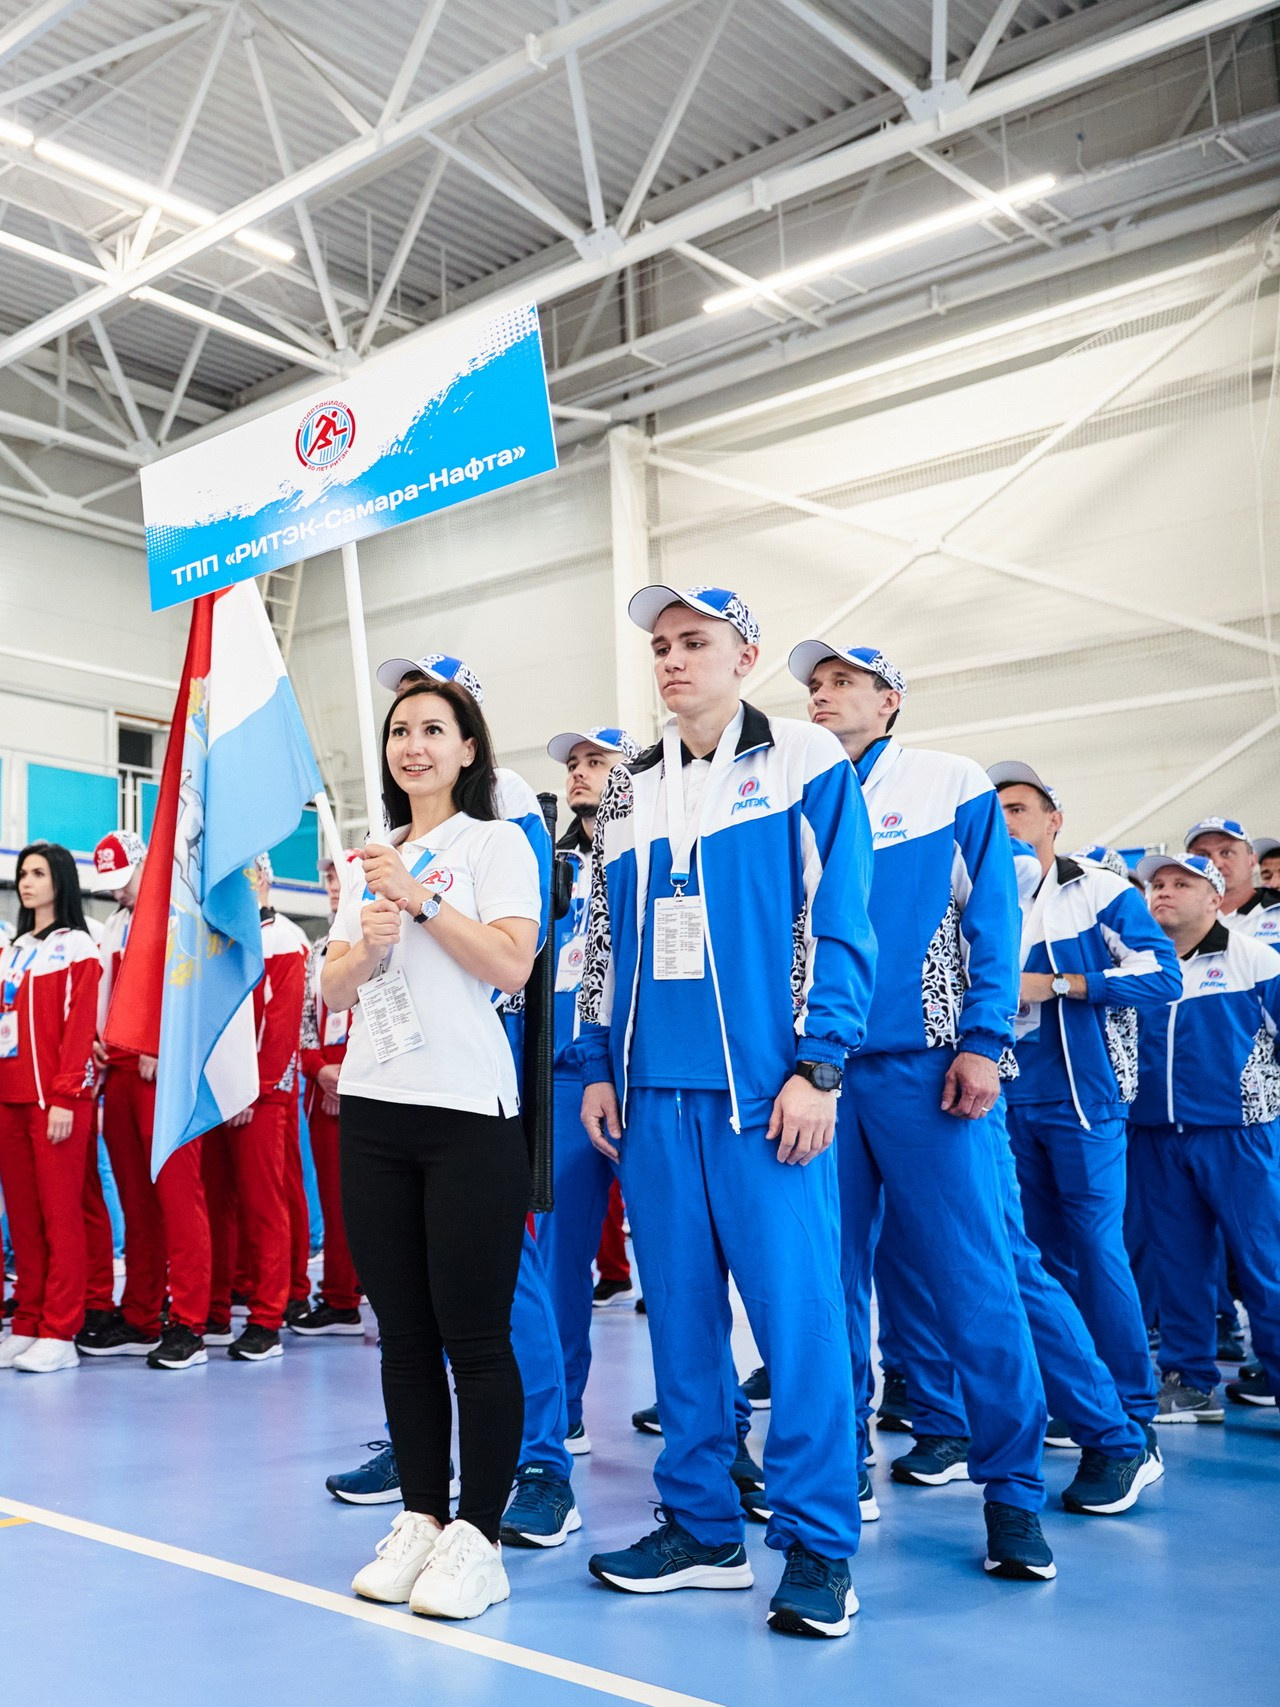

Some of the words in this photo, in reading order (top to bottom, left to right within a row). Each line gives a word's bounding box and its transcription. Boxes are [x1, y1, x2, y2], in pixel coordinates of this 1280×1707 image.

[300, 400, 347, 428] СПАРТАКИАДА
[171, 554, 219, 586] ТПП
[225, 445, 526, 566] «РИТЭК-Самара-Нафта»
